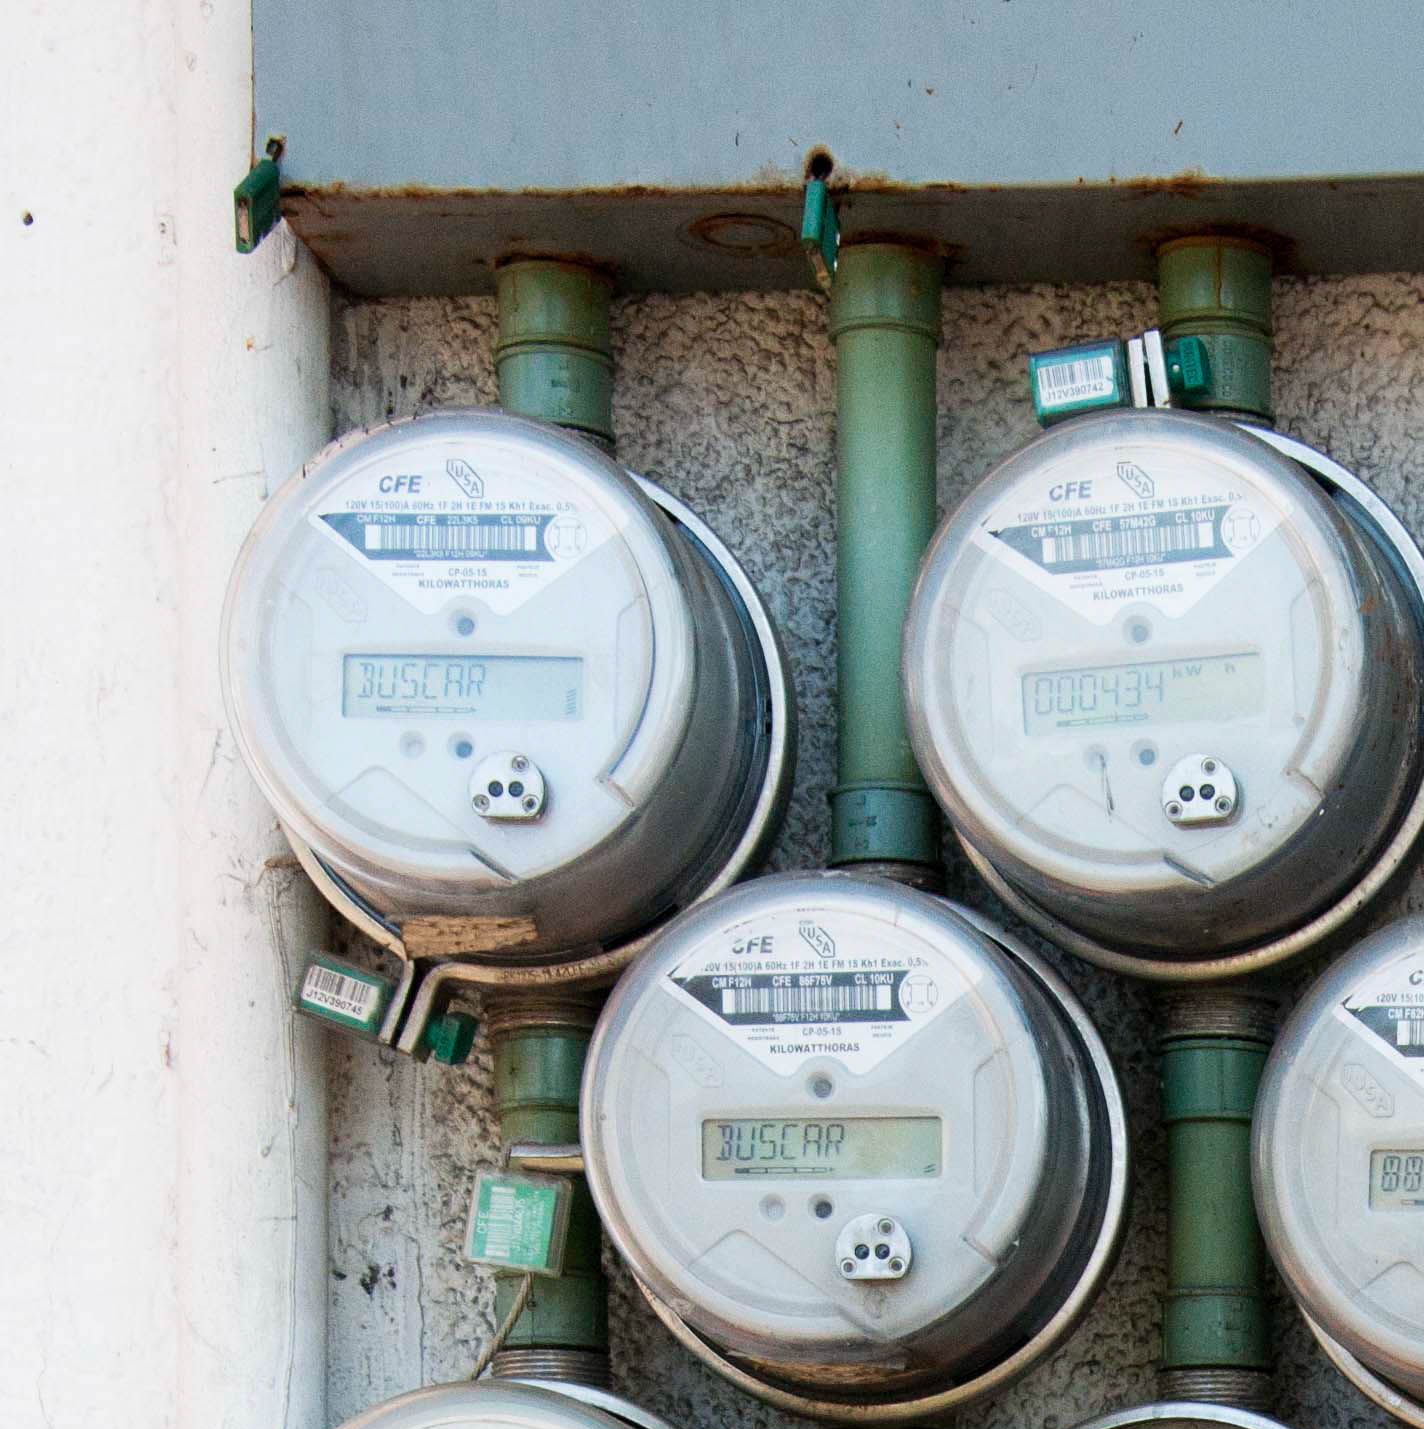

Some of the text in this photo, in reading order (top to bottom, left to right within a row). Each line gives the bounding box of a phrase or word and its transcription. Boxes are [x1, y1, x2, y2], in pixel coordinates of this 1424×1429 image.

[379, 475, 422, 494] CFE
[449, 461, 481, 496] IUSA
[1120, 464, 1150, 495] IUSA
[1049, 480, 1093, 501] CFE
[416, 515, 436, 524] CFE
[1175, 512, 1186, 523] CL
[1092, 520, 1112, 532] CFE
[418, 579, 509, 589] KILOWATTHORAS
[1093, 584, 1183, 600] KILOWATTHORAS
[357, 662, 487, 699] BUSCAR
[1035, 670, 1165, 715] 000434
[732, 936, 774, 954] CFE
[712, 976, 752, 989] CM F12H
[772, 975, 791, 987] CFE
[854, 972, 894, 984] CL 10KU
[306, 991, 363, 1016] J12V390745
[1388, 1008, 1403, 1019] CM
[769, 1043, 860, 1054] KILOWATTHORAS
[716, 1124, 845, 1160] BUSCAR
